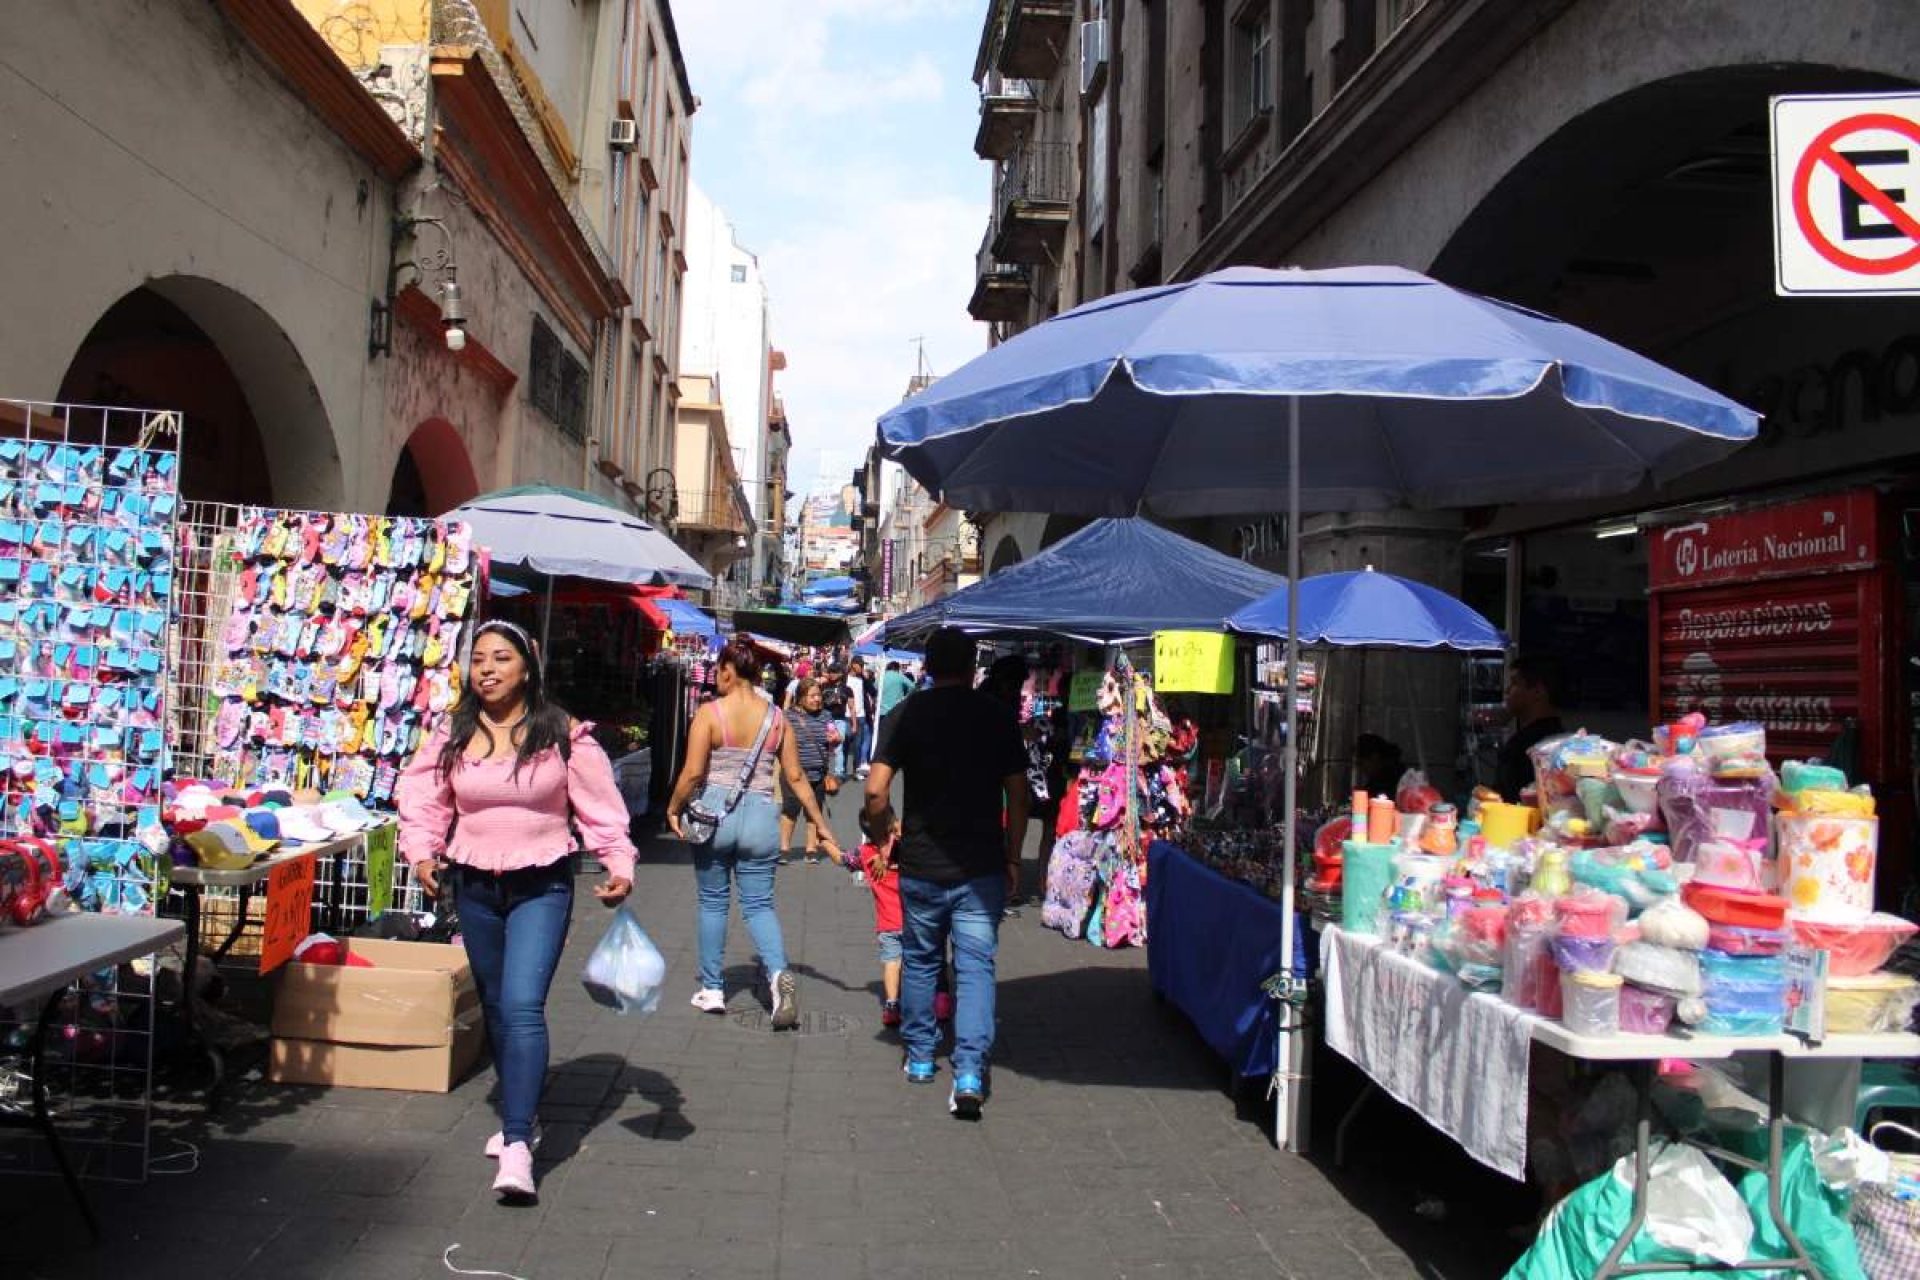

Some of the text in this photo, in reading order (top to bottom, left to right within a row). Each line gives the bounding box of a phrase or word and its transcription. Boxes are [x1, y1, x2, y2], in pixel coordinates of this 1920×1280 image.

[1838, 149, 1910, 240] E
[1702, 539, 1759, 571] Lotería
[1764, 525, 1845, 562] Nacional
